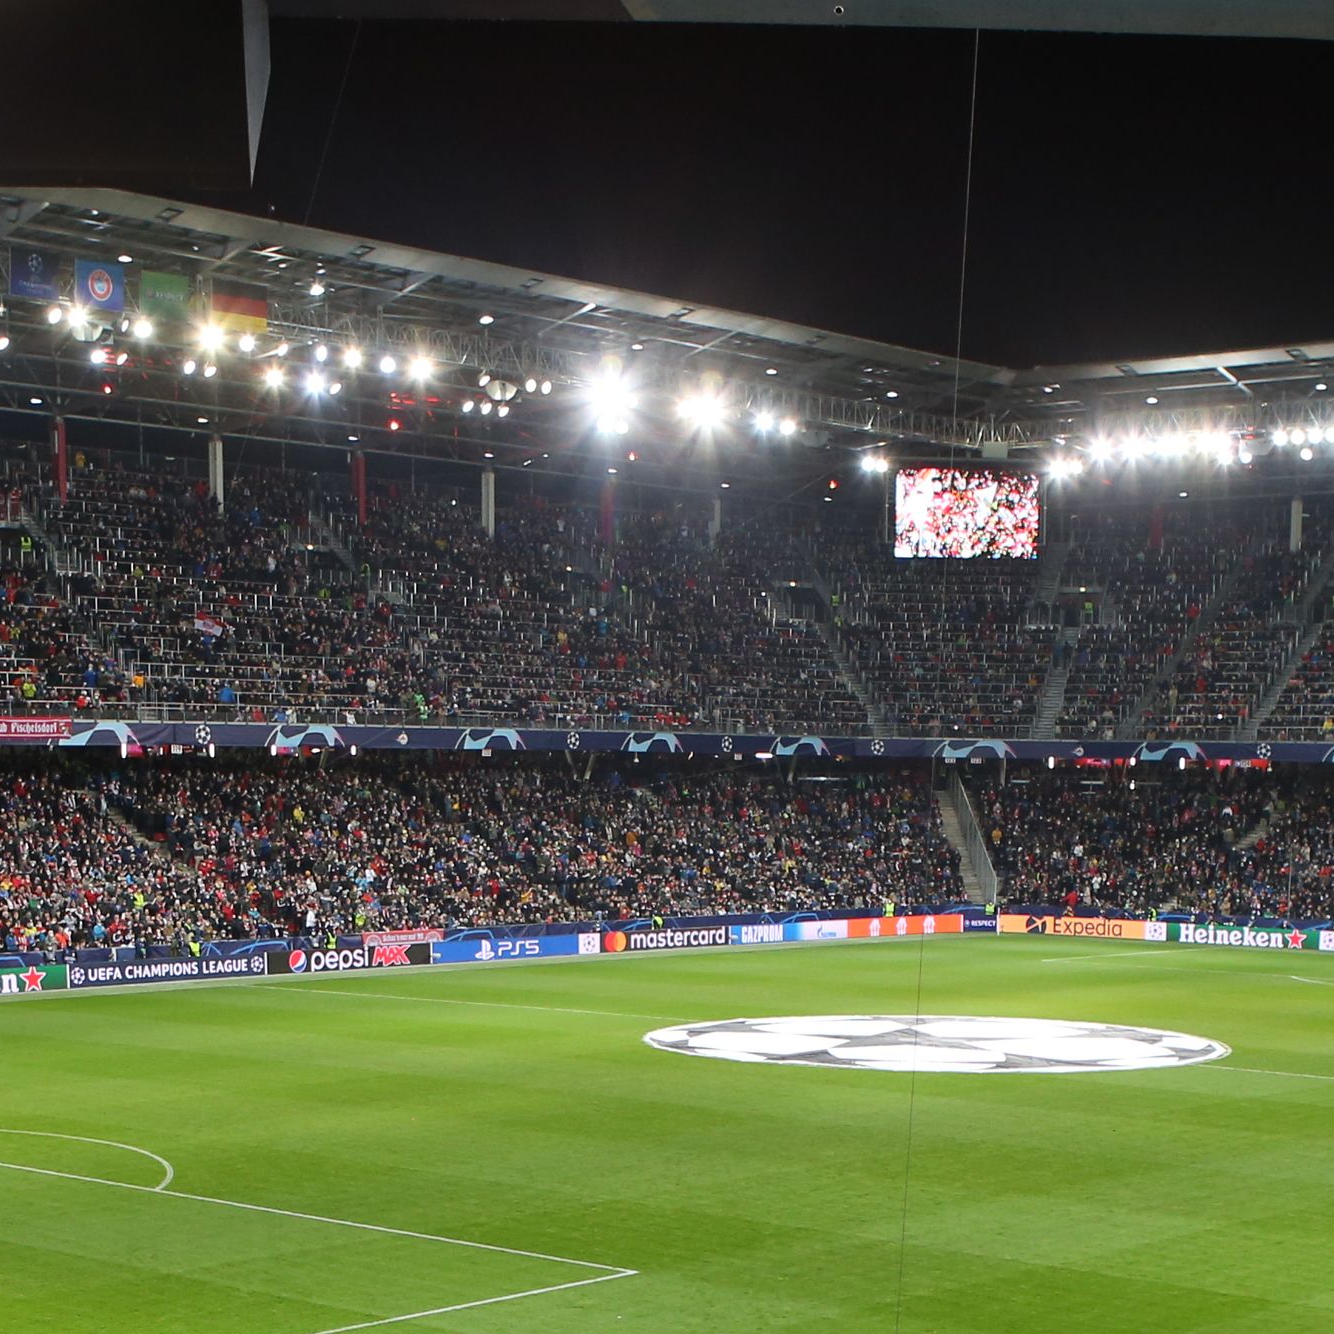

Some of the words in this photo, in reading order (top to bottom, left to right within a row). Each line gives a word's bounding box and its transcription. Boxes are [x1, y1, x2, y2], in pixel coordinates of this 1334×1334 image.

[11, 722, 57, 735] Pischelsdorf
[741, 923, 784, 944] GAZPROM
[971, 919, 997, 928] RESPECT
[1052, 916, 1123, 939] Expedia
[630, 925, 726, 950] mastercard
[1178, 923, 1285, 949] Heineken
[310, 943, 369, 973] pepsi
[372, 943, 411, 967] MAX
[498, 941, 540, 959] PS5
[87, 964, 123, 982] UEFA
[125, 960, 200, 980] CHAMPIONS
[202, 956, 249, 975] LEAGUE
